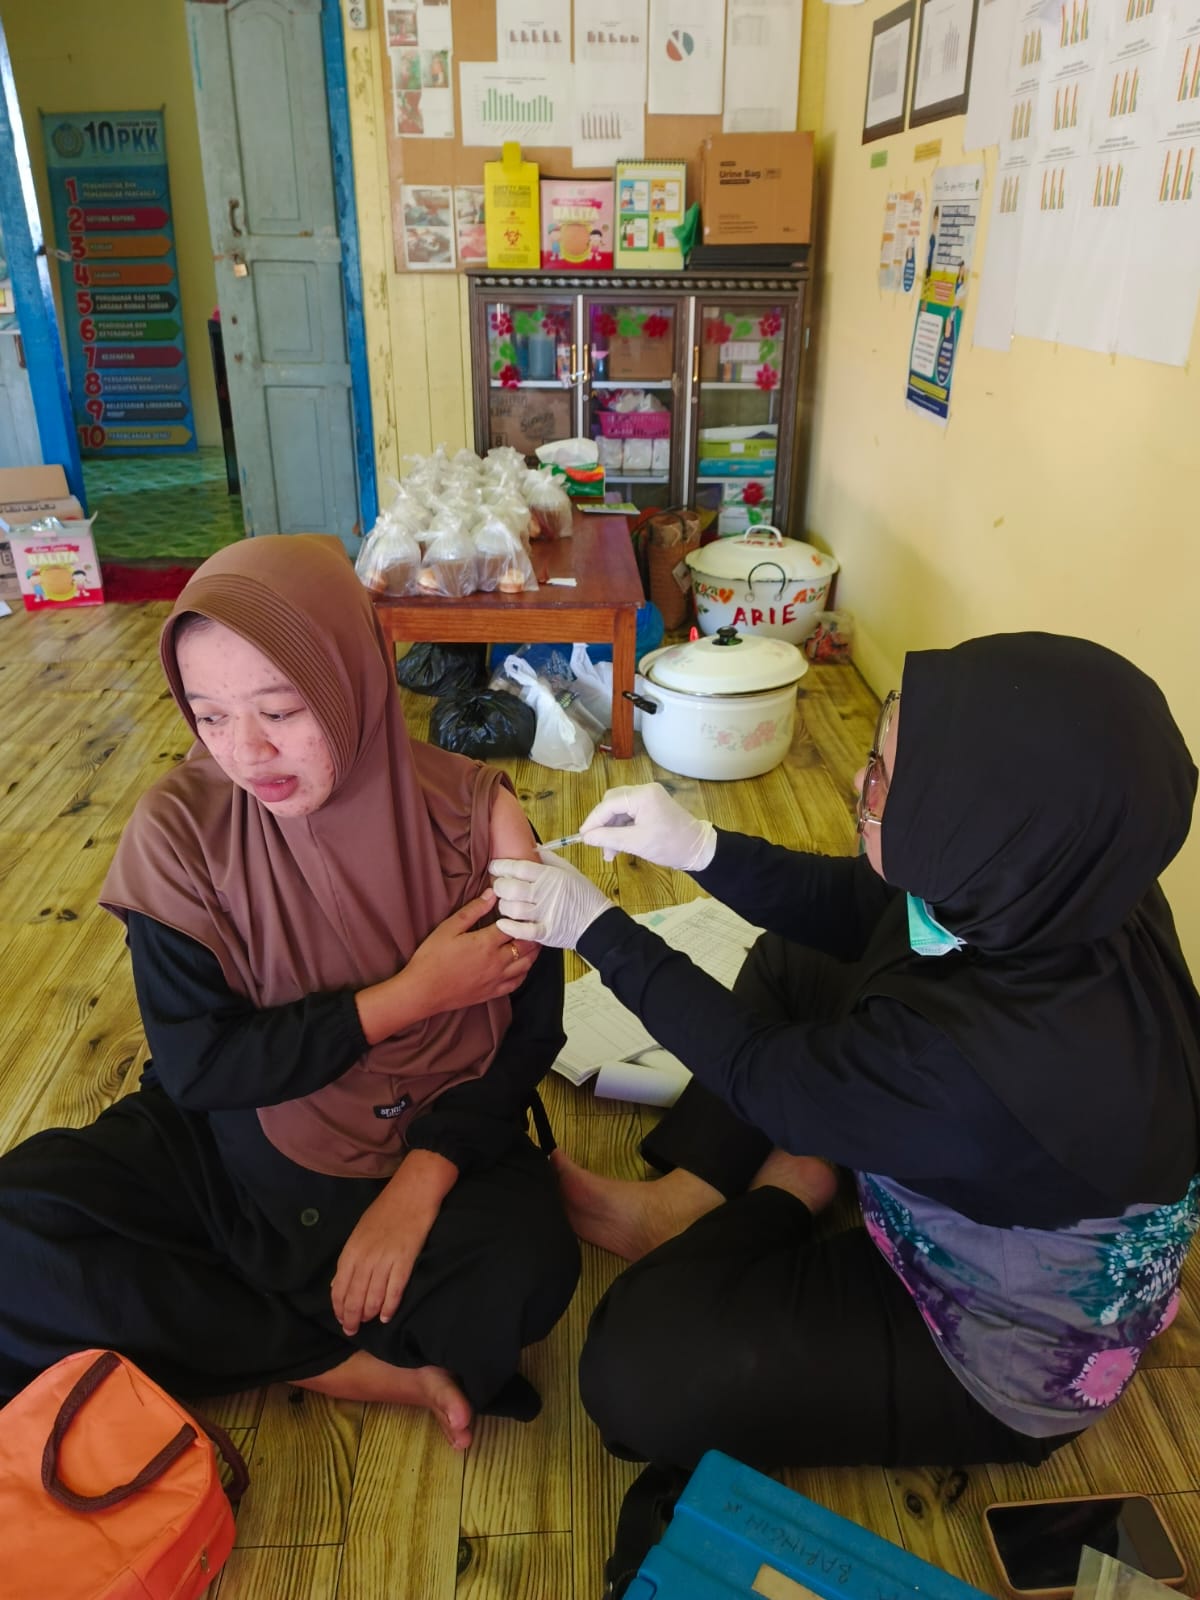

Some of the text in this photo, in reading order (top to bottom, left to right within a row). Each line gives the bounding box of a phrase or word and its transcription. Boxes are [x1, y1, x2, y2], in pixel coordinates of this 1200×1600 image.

[83, 121, 160, 154] 10 PKK
[719, 169, 742, 179] Urine
[744, 168, 761, 180] Bag
[64, 176, 79, 203] 1
[67, 207, 85, 233] 2
[69, 235, 87, 261] 3
[74, 263, 91, 288] 4
[76, 290, 94, 316] 5
[79, 317, 97, 343] 6
[83, 345, 96, 370] 7
[84, 371, 102, 397] 8
[86, 398, 104, 423] 9
[78, 424, 106, 450] 10
[731, 603, 796, 627] ARIE
